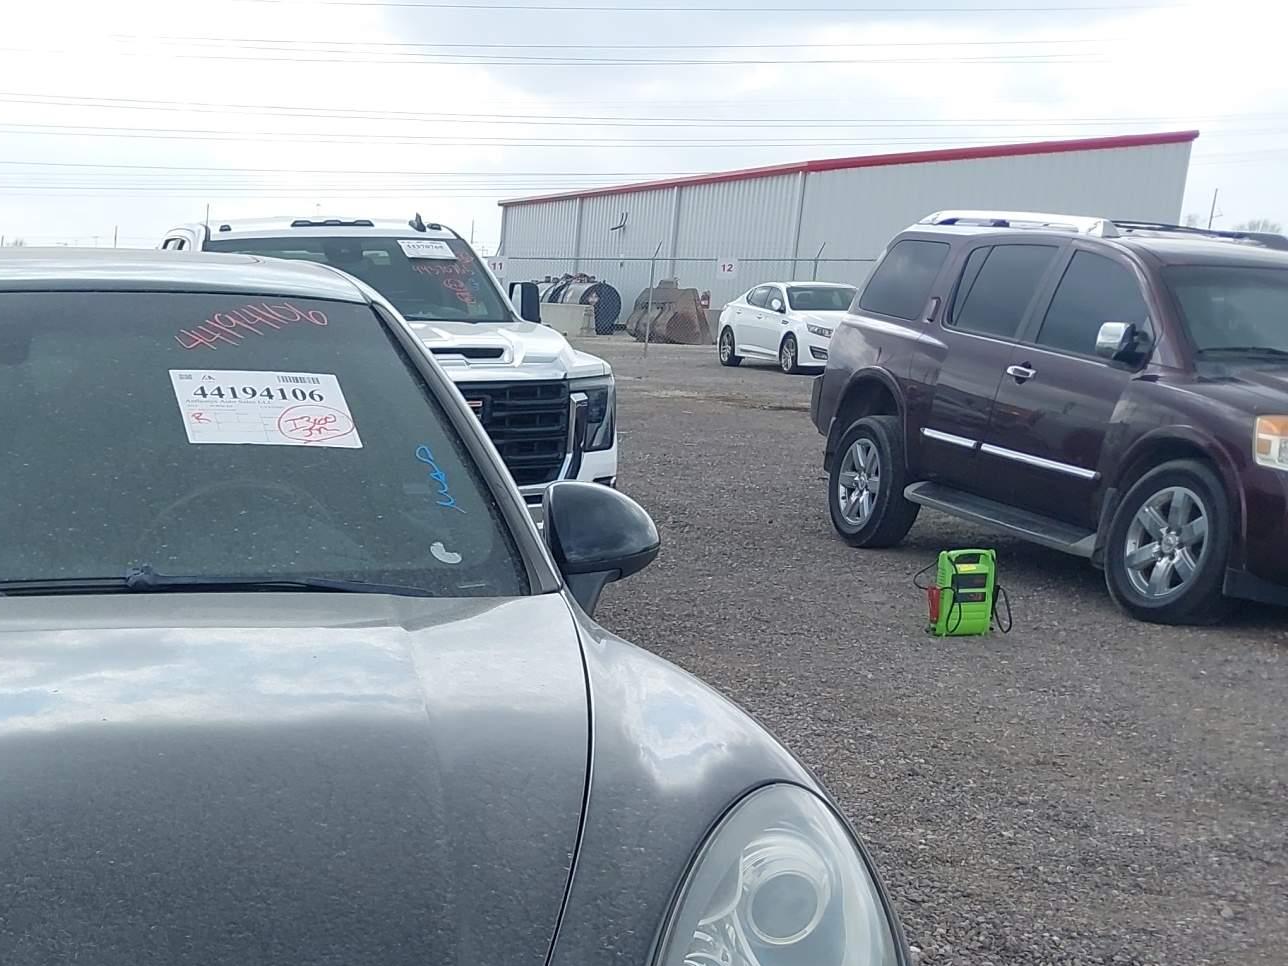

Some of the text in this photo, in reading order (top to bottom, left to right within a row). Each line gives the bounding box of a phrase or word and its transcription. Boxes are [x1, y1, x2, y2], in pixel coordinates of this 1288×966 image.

[491, 262, 503, 271] 11
[721, 263, 734, 273] 12
[174, 302, 328, 350] 44194106
[193, 385, 324, 402] 44194106
